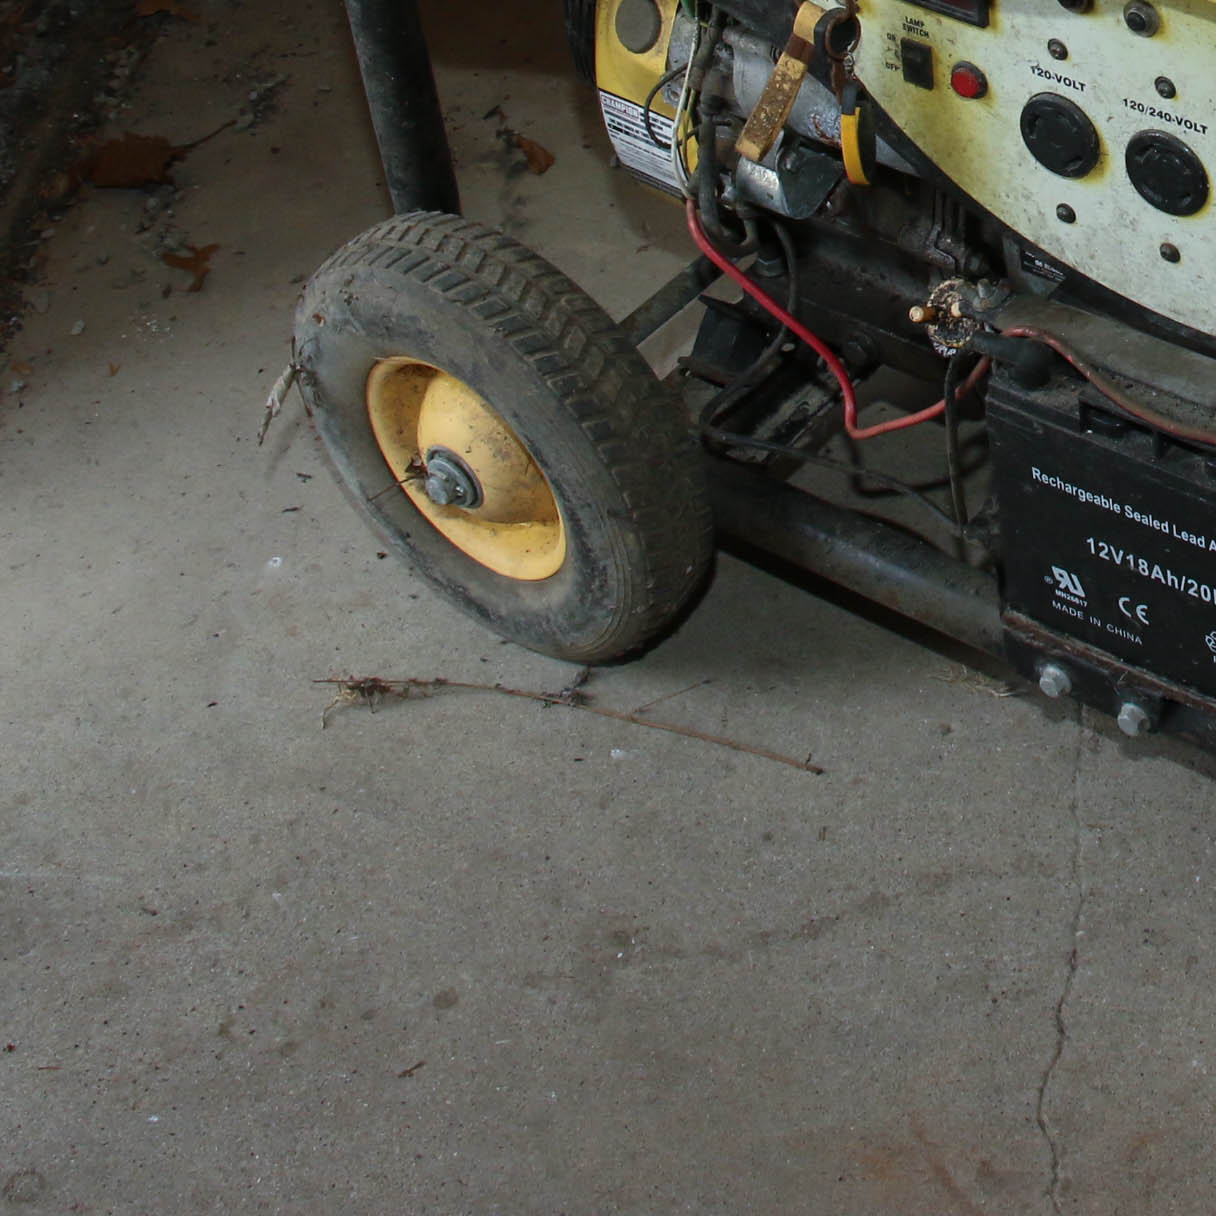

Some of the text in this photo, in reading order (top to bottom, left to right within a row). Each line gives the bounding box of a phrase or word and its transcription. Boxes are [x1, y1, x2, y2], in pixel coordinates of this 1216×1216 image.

[902, 23, 929, 38] SWITCH
[905, 16, 925, 28] LAMP
[1030, 65, 1087, 93] 120-VOLT
[601, 95, 639, 119] CHAMPION
[1122, 98, 1208, 135] 120/240-VOLT
[1031, 466, 1121, 515] Rechargeable
[1124, 504, 1169, 534] Sealed
[1172, 523, 1206, 549] Lead
[1052, 600, 1144, 645] MADE IN CHINA
[1118, 596, 1150, 625] CE
